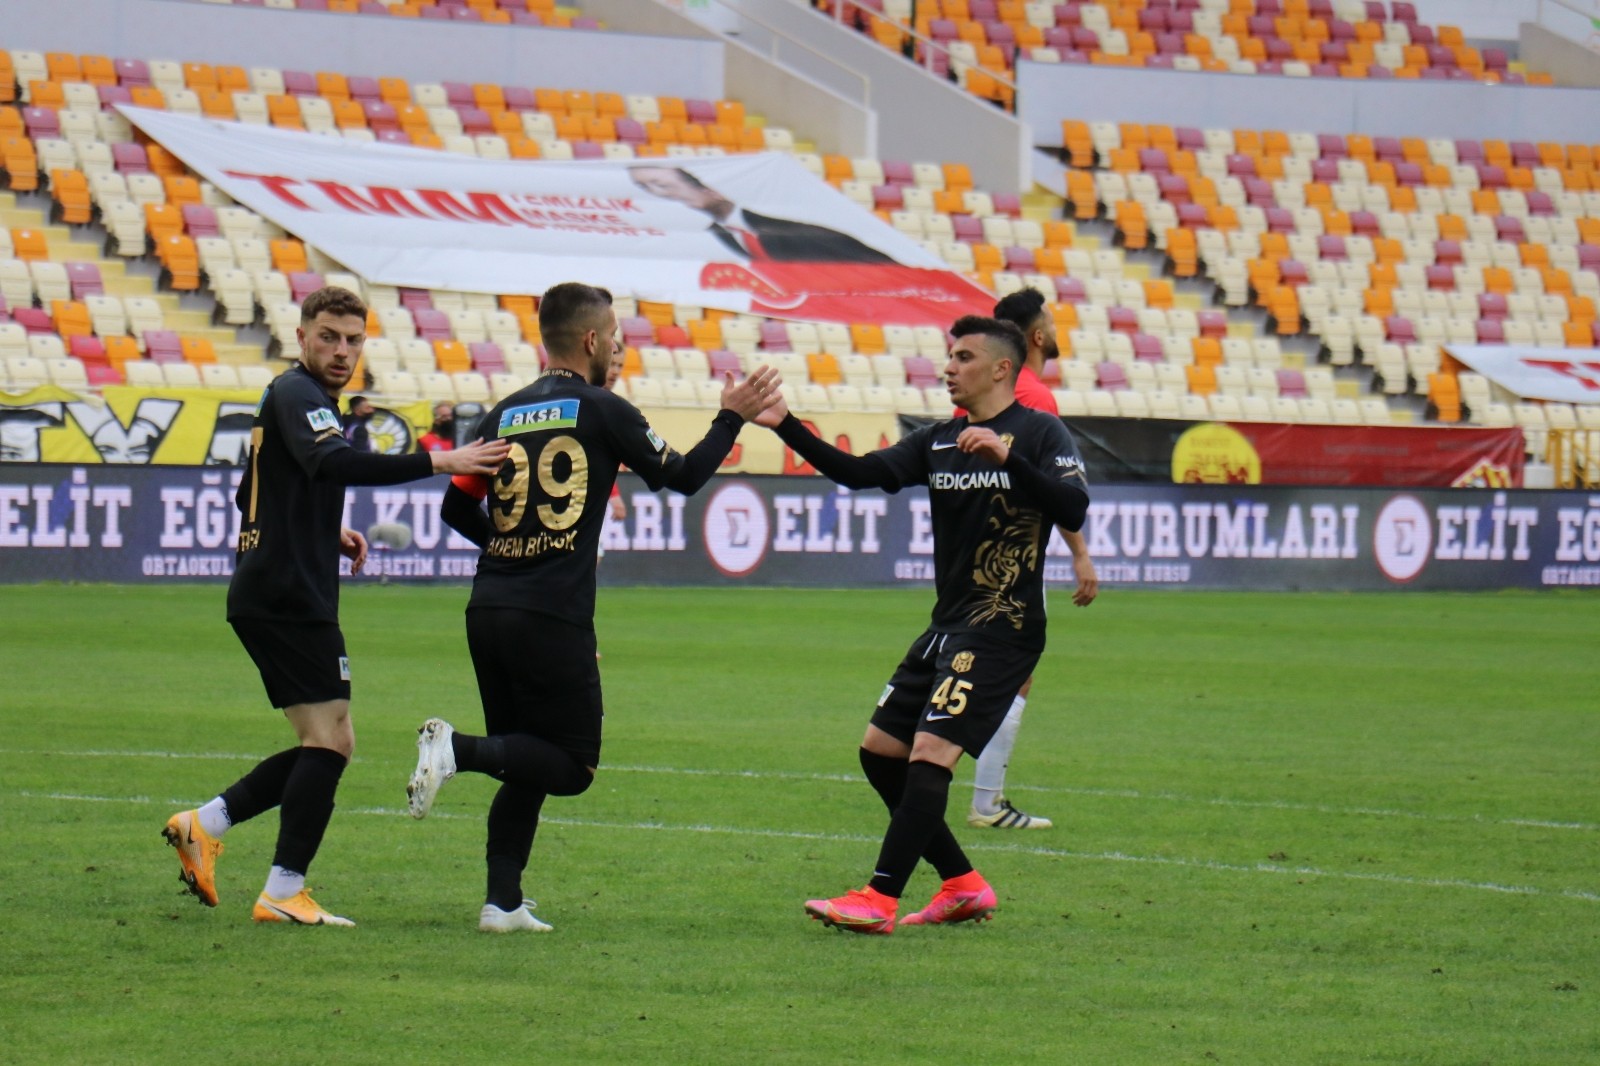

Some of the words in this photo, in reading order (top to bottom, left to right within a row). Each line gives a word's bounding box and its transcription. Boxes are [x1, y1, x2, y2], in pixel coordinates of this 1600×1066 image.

[511, 407, 562, 427] aksa
[0, 467, 132, 548] ELİT
[160, 470, 243, 548] EĞİ
[493, 435, 588, 533] 99
[929, 471, 1000, 491] MEDICANA
[773, 484, 887, 553] ELİT
[1087, 503, 1359, 559] KURUMLARI
[1435, 491, 1539, 560] ELİT
[931, 676, 974, 715] 45
